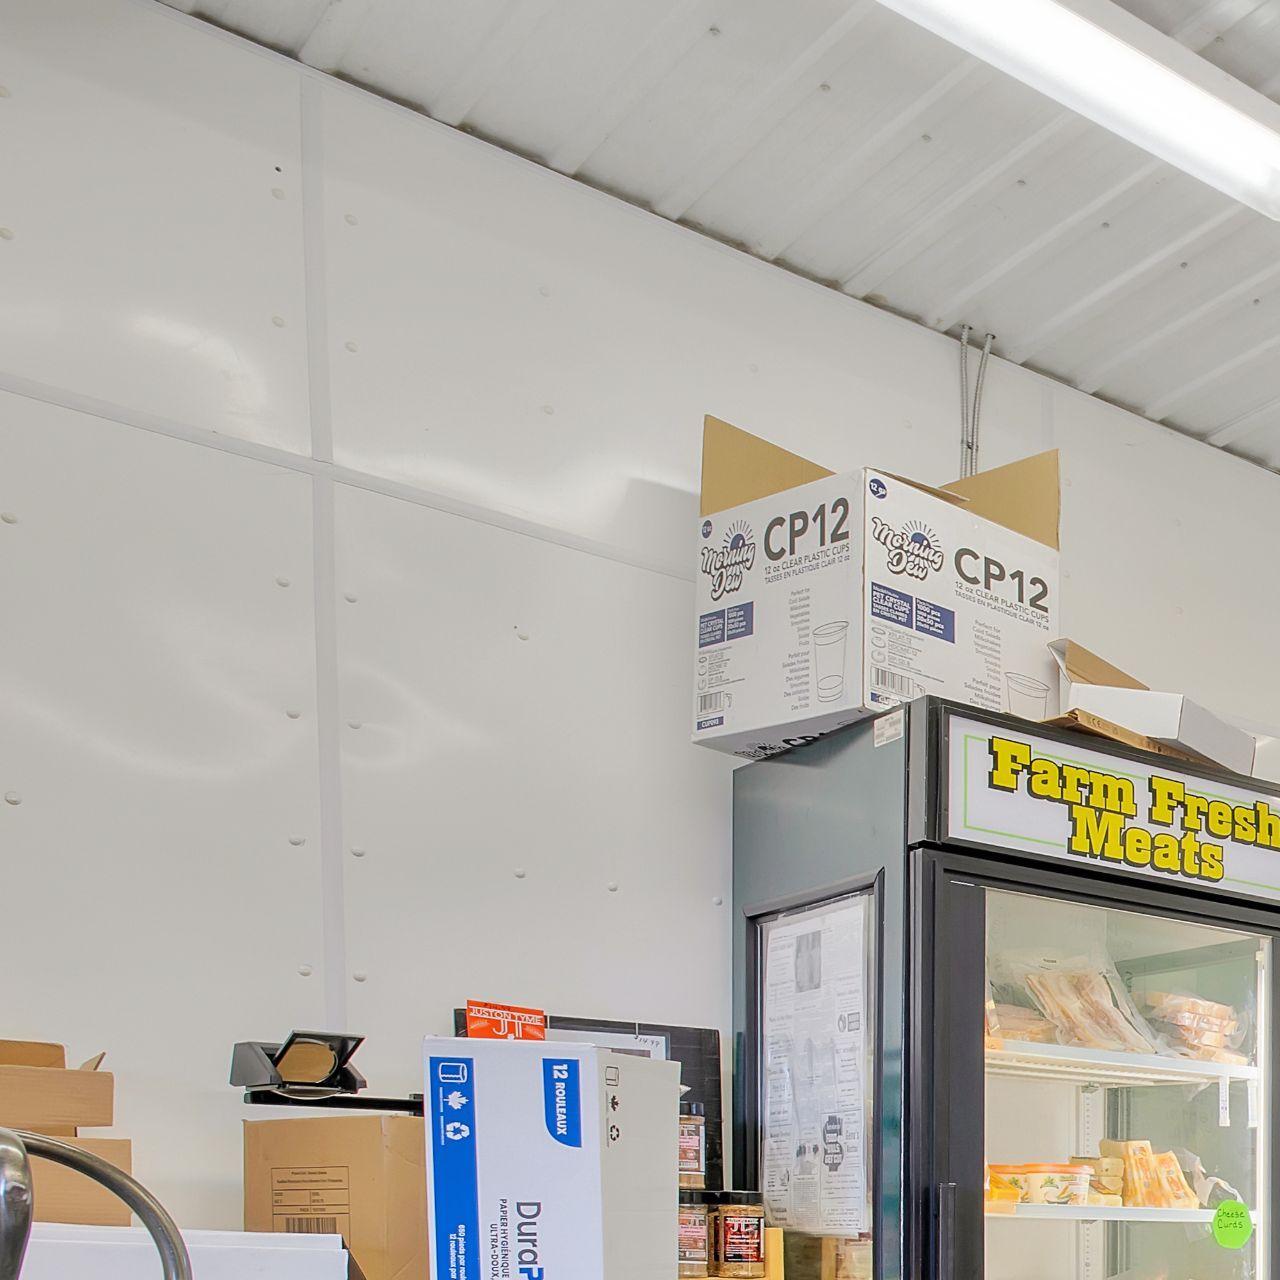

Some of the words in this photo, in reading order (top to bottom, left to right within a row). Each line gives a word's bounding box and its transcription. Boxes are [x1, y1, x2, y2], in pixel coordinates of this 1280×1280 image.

[764, 498, 849, 561] CP12
[872, 517, 944, 572] Morning
[701, 543, 755, 574] Morning
[782, 557, 802, 570] CLEAR
[804, 551, 830, 563] PLASTIC
[832, 544, 850, 555] CUPS
[887, 549, 928, 581] Dew
[711, 569, 742, 601] Dew
[765, 575, 782, 583] TASSES
[792, 563, 820, 577] PLASTIQUE
[955, 548, 1048, 613] CP12
[873, 590, 884, 599] PET
[886, 595, 911, 609] CRYSTAL
[873, 598, 891, 608] CLEAR
[893, 603, 909, 614] CUPS
[955, 581, 963, 589] 12
[976, 589, 999, 603] CLEAR
[1001, 598, 1029, 615] PLASTIC
[1031, 609, 1049, 622] CUPS
[955, 590, 975, 602] TASSES
[987, 601, 1017, 618] PLASTIQUE
[1019, 613, 1035, 625] CLAIR
[988, 736, 1136, 816] Farm
[1068, 804, 1224, 882] Meats
[515, 1014, 543, 1024] TYME
[553, 1064, 568, 1079] 12
[555, 1082, 568, 1135] ROULEAUX
[1218, 1209, 1245, 1218] Cheese
[1218, 1219, 1243, 1228] Curds
[458, 1257, 466, 1266] par
